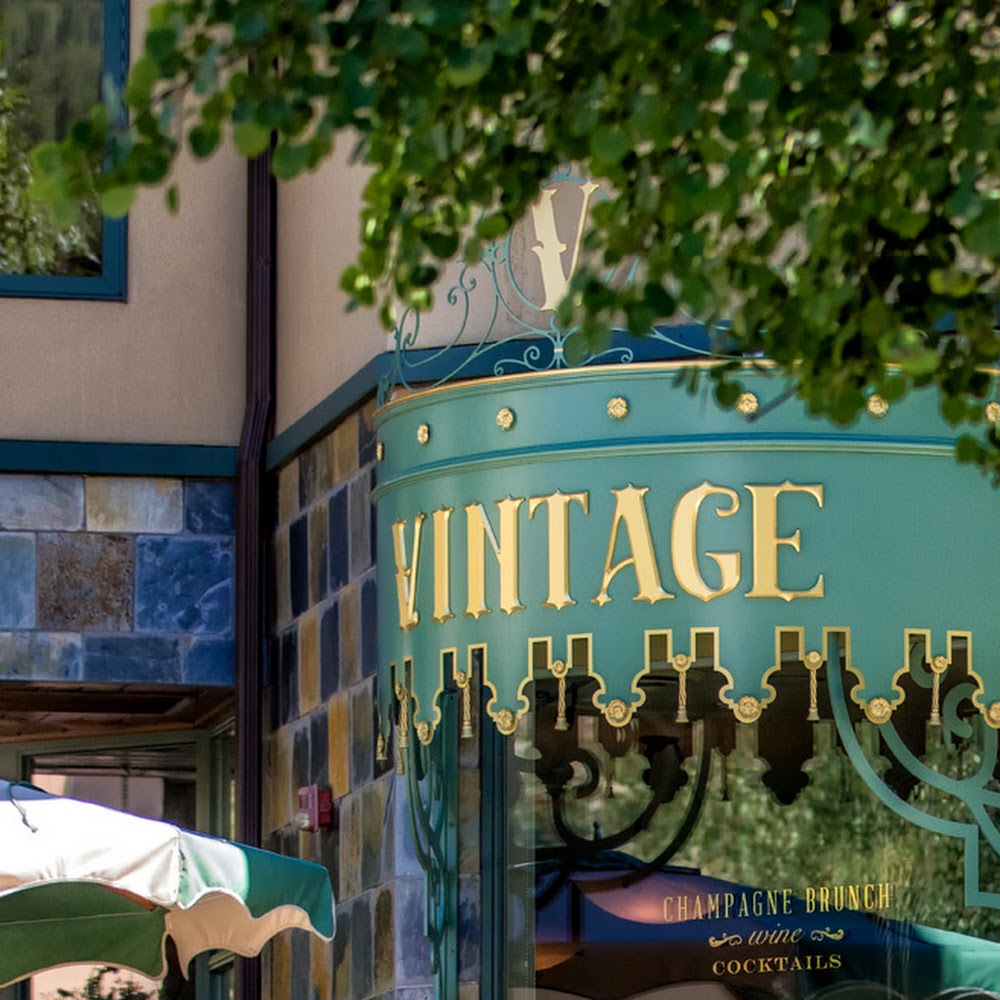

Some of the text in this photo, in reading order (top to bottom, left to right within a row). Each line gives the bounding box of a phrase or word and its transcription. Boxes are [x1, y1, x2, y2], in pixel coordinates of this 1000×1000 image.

[531, 180, 600, 311] V
[391, 479, 824, 632] VINTAGE
[663, 883, 890, 922] CHAMPAGNE BRUNCH
[748, 923, 804, 945] wine
[712, 954, 842, 975] COCKTAILS
